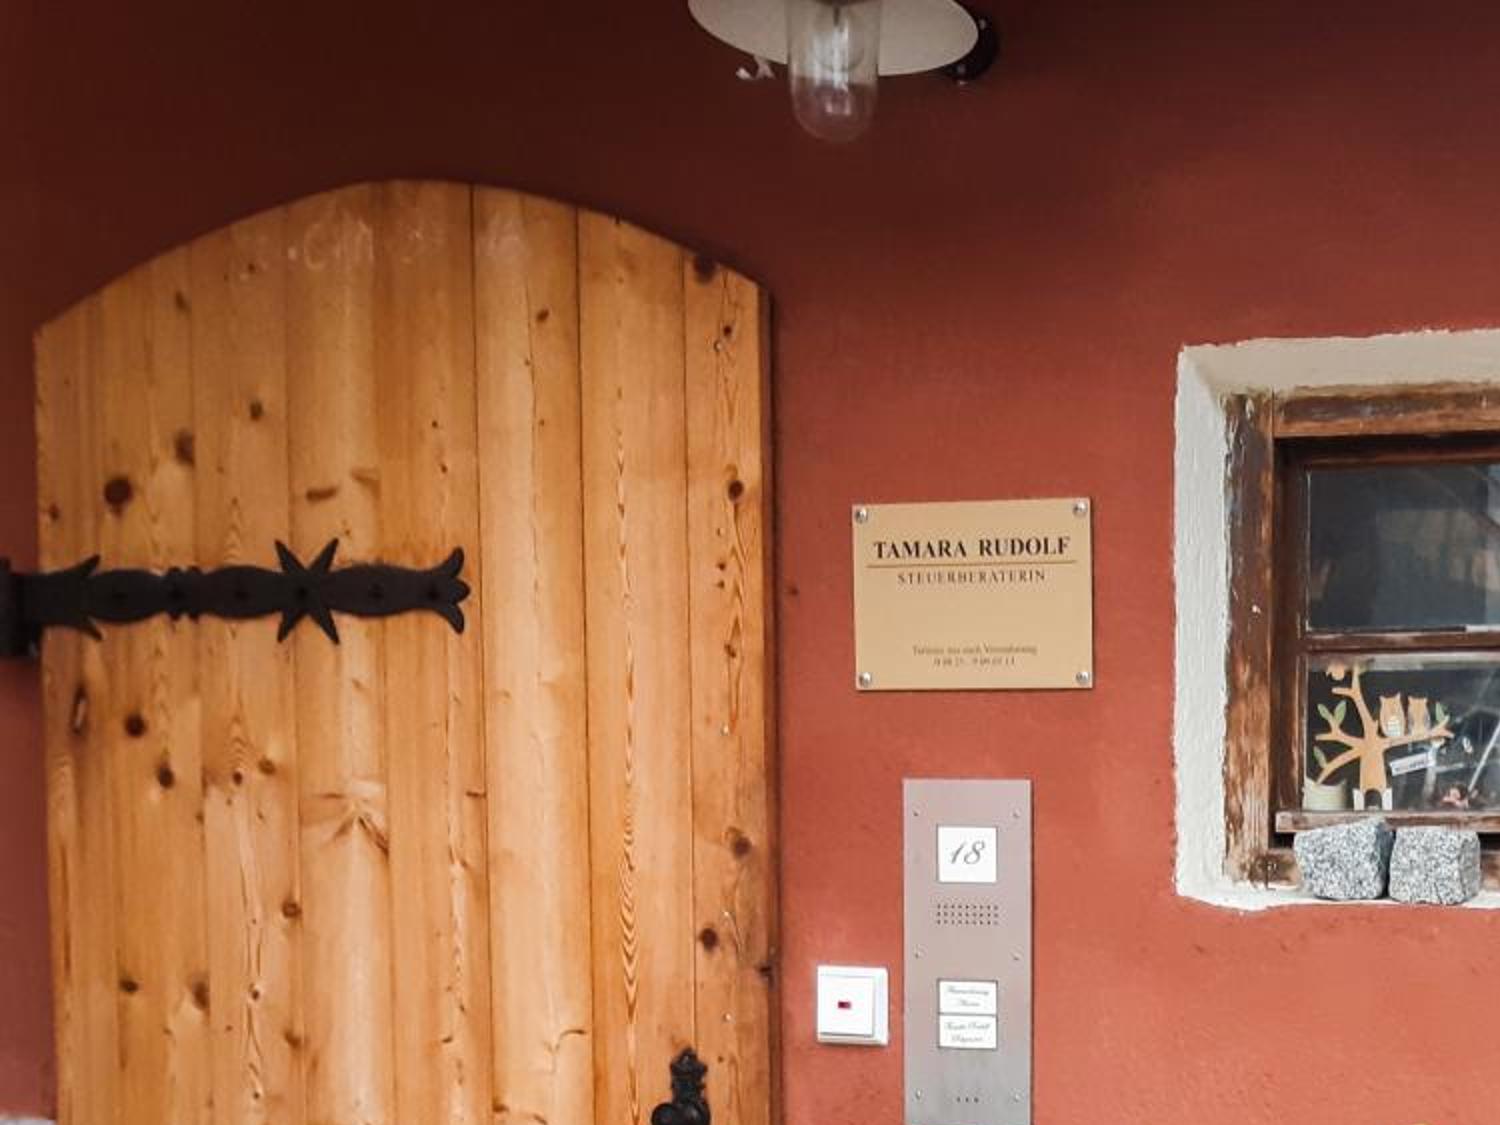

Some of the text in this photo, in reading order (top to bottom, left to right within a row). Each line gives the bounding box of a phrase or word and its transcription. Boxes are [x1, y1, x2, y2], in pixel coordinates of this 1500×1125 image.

[873, 536, 1071, 559] TAMARA RUDOLF
[897, 569, 1045, 586] STEUERBERATERIN
[948, 840, 986, 865] 18
